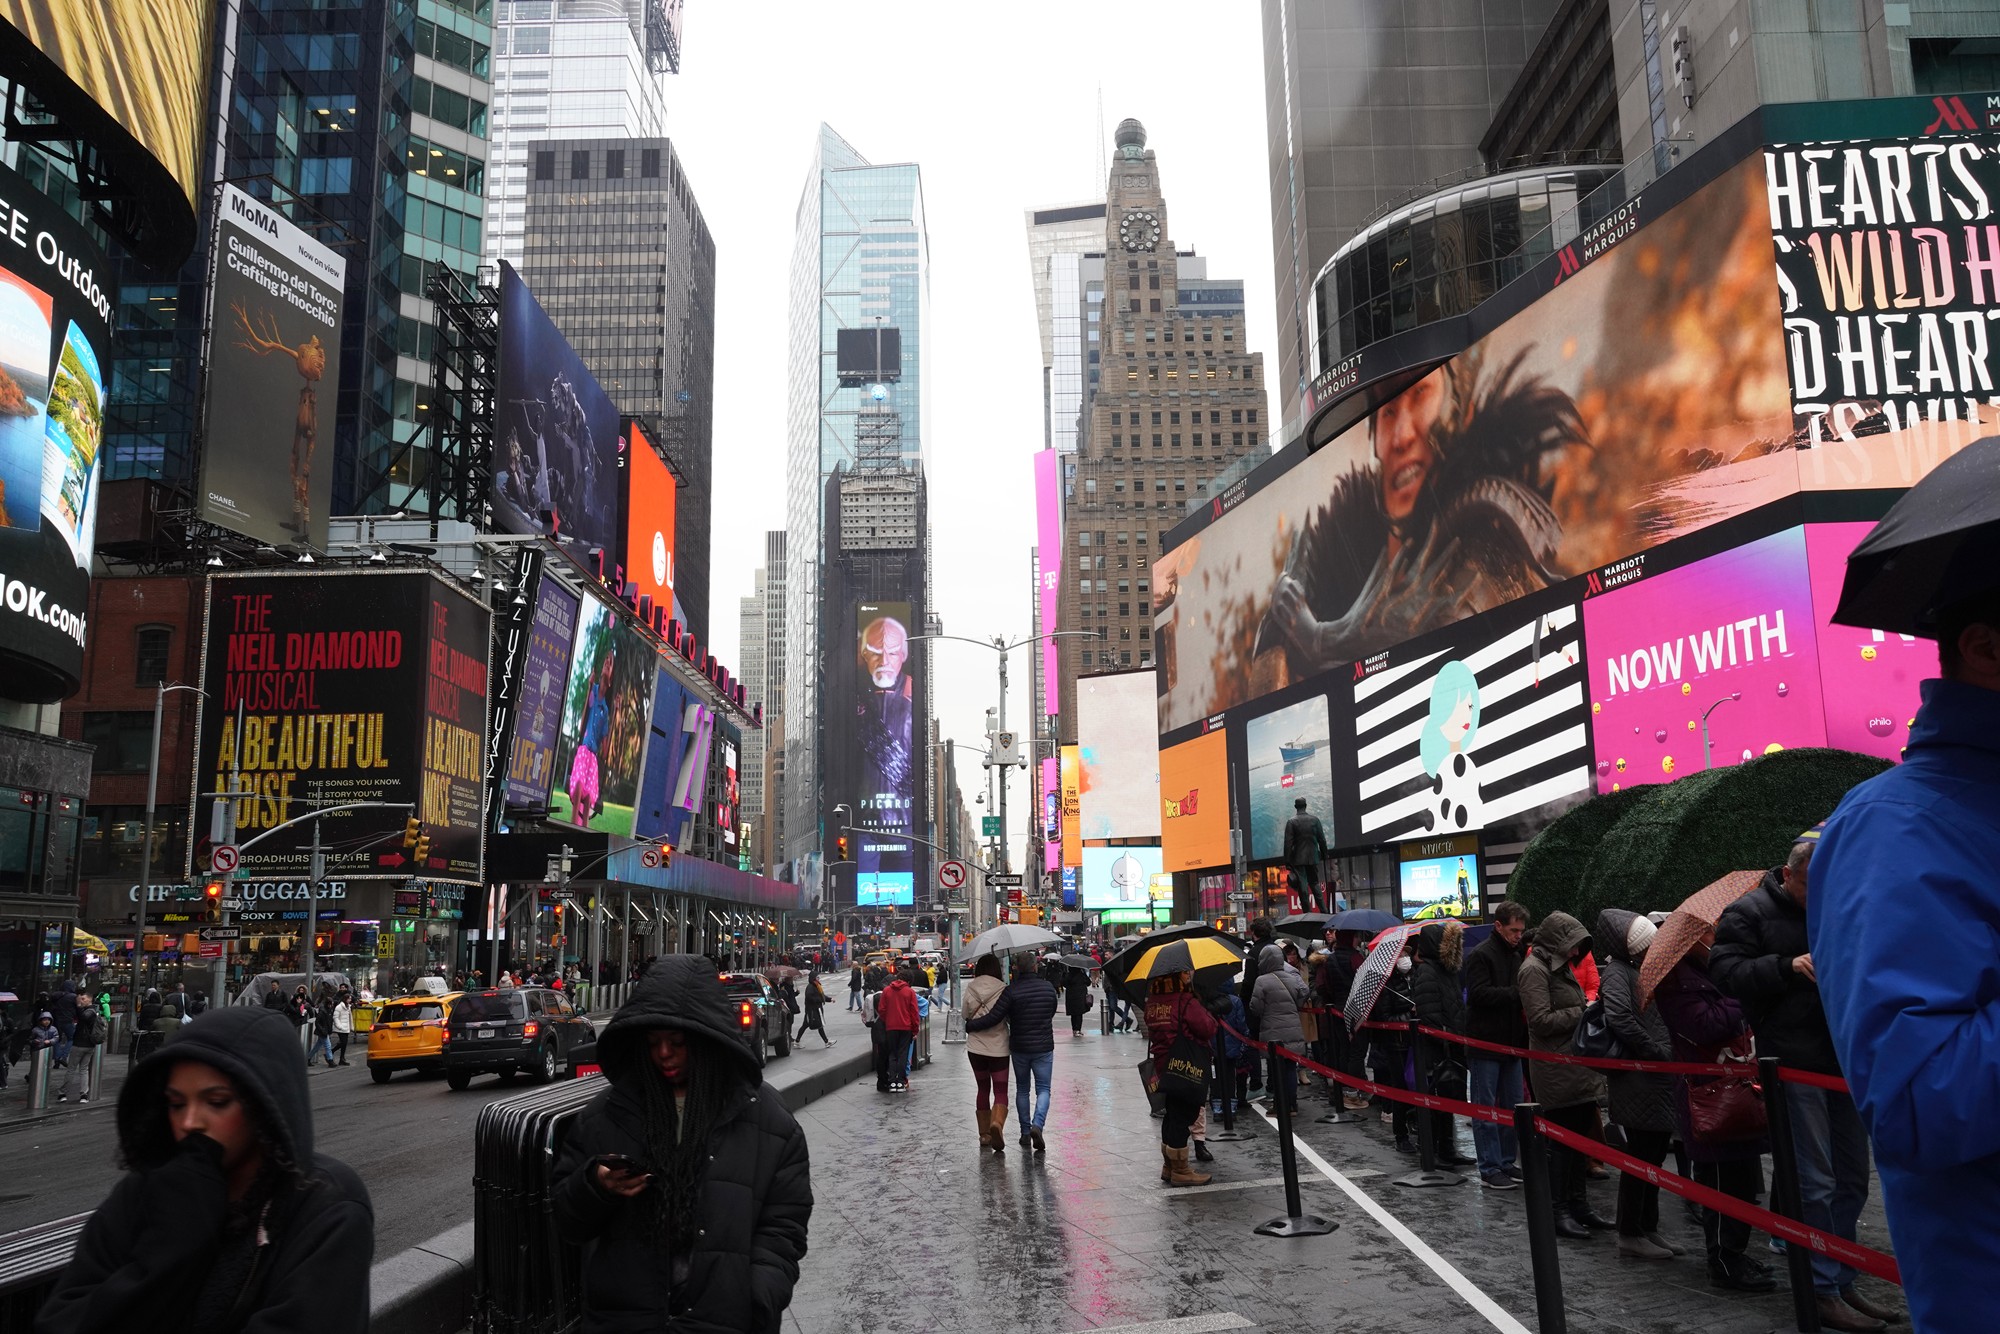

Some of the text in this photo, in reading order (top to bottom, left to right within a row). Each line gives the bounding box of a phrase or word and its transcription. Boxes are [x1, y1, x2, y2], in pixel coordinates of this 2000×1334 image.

[1763, 143, 1995, 229] HEARTS
[231, 194, 279, 239] MoMA
[1583, 196, 1642, 246] MARRIOTT
[1584, 217, 1636, 261] MARQUIS
[36, 231, 111, 324] Outdoor
[228, 235, 338, 314] Guillermo del Toro:
[298, 245, 340, 279] Now on view
[1807, 227, 1956, 312] WILD
[227, 253, 336, 328] Crafting Pinocchio
[1316, 353, 1363, 390] MARRIOTT
[1317, 371, 1357, 404] MARQUIS
[208, 492, 236, 508] CHANEL
[1223, 477, 1248, 501] MARRIOTT
[1223, 490, 1246, 510] MARQUIS
[1604, 554, 1645, 577] MARRIOTT
[1605, 568, 1641, 588] MARQUIS
[232, 594, 273, 632] THE
[433, 600, 448, 642] THE
[589, 547, 747, 709] 1540 BROADWAY
[227, 630, 402, 672] NEIL DIAMOND
[430, 638, 487, 697] NEIL DIAMOND
[1364, 651, 1390, 666] MARRIOTT
[1365, 660, 1388, 674] MARQUIS
[1607, 608, 1787, 696] NOW WITH
[224, 671, 320, 711] MUSICAL
[428, 675, 461, 722] MUSICAL
[1655, 729, 1667, 738] philo
[1869, 717, 1892, 728] philo
[216, 713, 389, 771] A BEAUTIFUL
[425, 716, 481, 783] A BEAUTIFUL
[511, 736, 553, 789] LIFE OF PI
[1597, 760, 1610, 770] philo
[353, 790, 383, 798] YOU'VE
[423, 771, 452, 828] NOISE
[861, 799, 910, 809] PICARD
[1064, 798, 1079, 807] LION
[1063, 806, 1080, 817] KING
[240, 855, 313, 864] BROADHURS
[1421, 841, 1454, 855] INVICTA
[432, 882, 466, 900] LUGGAGE
[163, 914, 190, 922] Nikon
[241, 912, 275, 920] SONY
[282, 911, 309, 920] BOWER
[380, 935, 388, 955] ATM
[1168, 1058, 1204, 1077] Harry Potter
